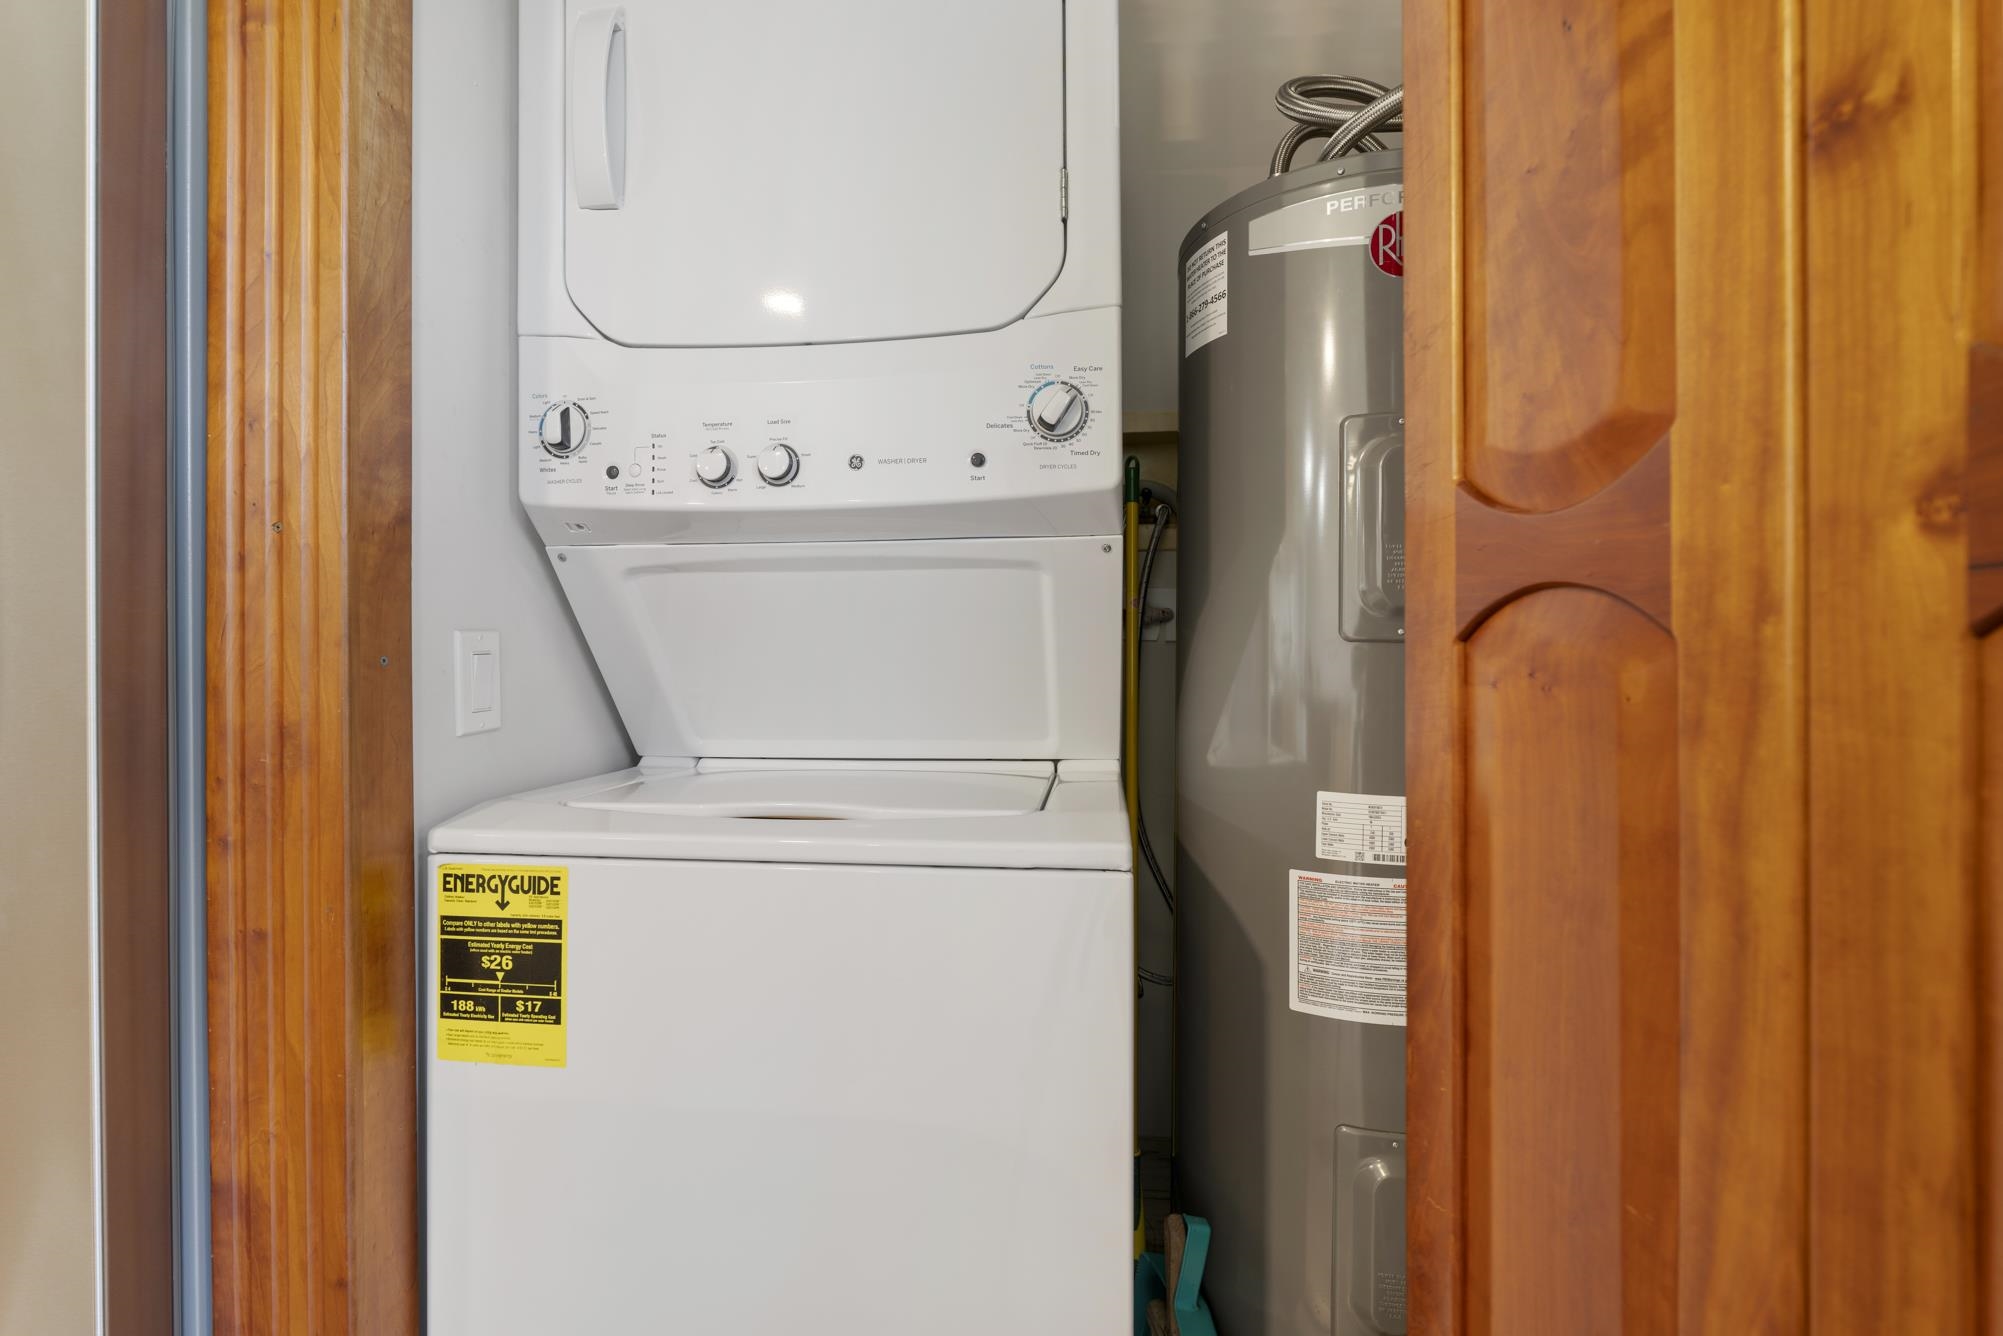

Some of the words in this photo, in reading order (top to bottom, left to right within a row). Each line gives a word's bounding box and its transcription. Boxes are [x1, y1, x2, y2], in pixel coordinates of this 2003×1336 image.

[1198, 245, 1215, 262] RETURN
[1216, 238, 1227, 250] THIS
[1210, 252, 1217, 262] TO
[1218, 247, 1227, 257] THE
[1202, 258, 1225, 279] PURCHASE
[442, 872, 561, 896] ENERGYGUIDE
[490, 942, 504, 950] Yearly
[482, 954, 513, 970] $26
[450, 1000, 474, 1012] 188
[516, 1000, 542, 1012] $17
